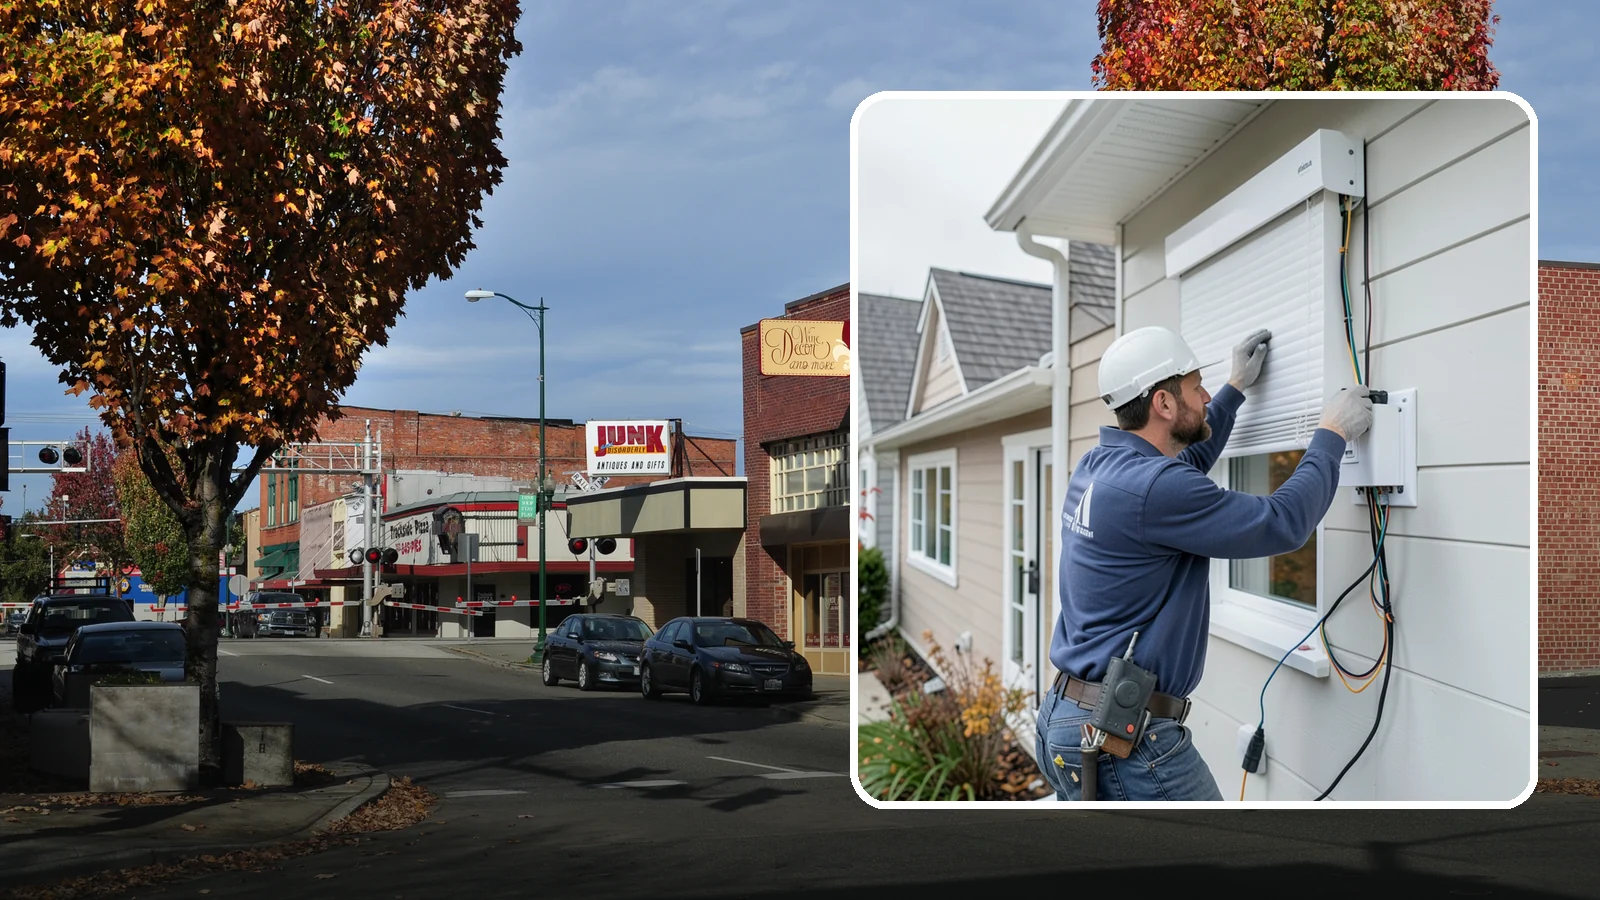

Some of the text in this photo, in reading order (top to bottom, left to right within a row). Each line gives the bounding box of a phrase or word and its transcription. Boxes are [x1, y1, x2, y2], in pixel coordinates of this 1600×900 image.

[764, 327, 831, 366] Decor
[596, 425, 664, 457] JUNK
[607, 446, 646, 454] DISORDERLY
[597, 460, 665, 470] ANTIQUES AND GIFTS
[414, 519, 429, 535] Pizza
